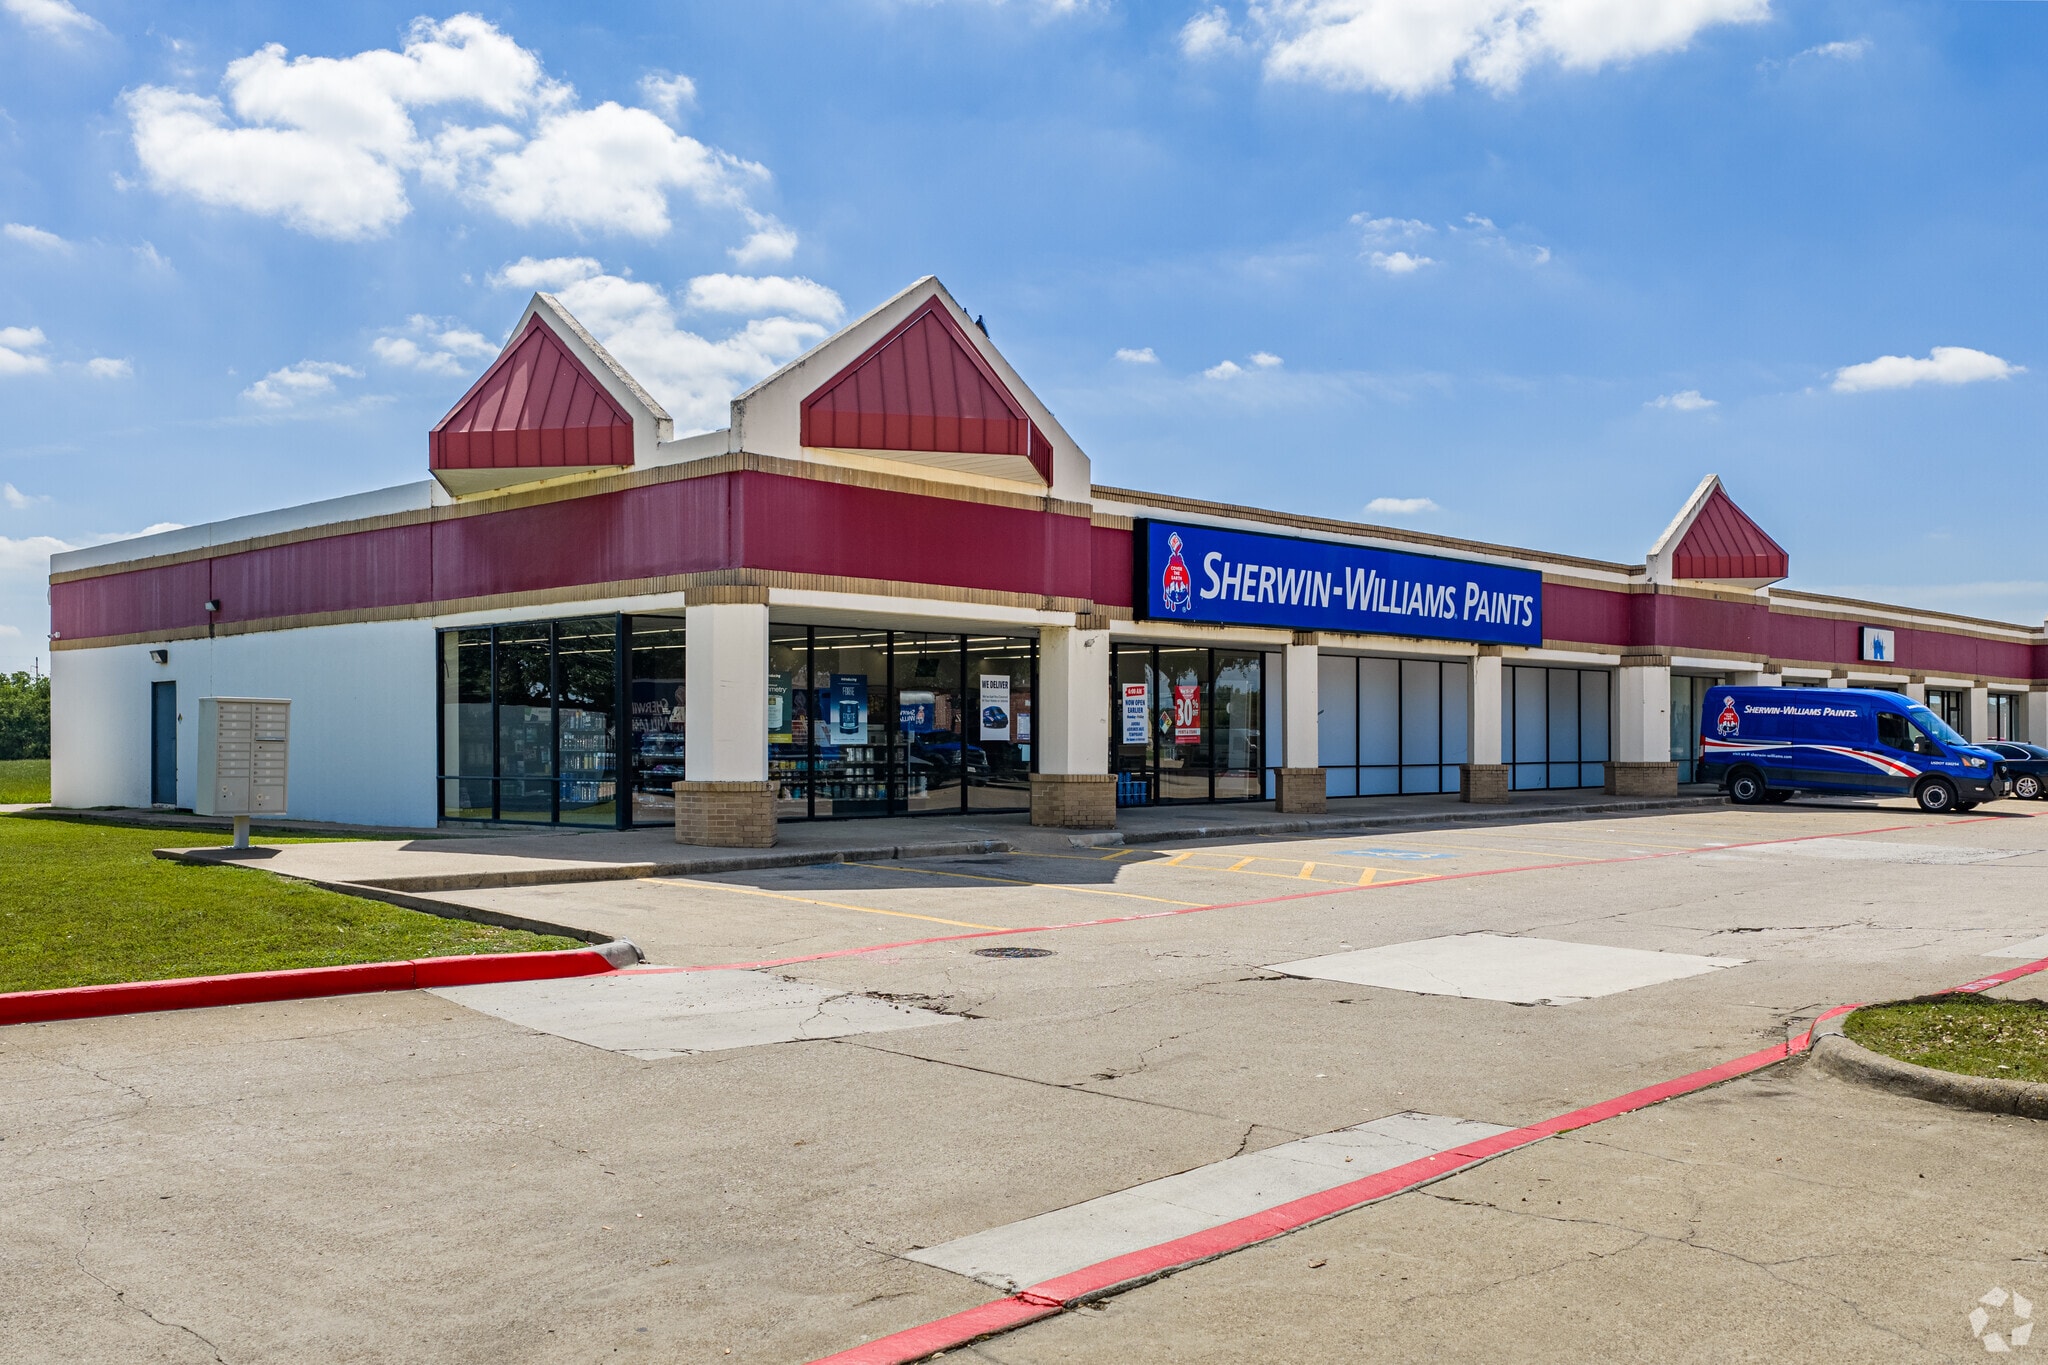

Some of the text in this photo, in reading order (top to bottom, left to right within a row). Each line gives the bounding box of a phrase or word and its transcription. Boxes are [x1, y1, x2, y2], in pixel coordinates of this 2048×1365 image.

[1200, 551, 1534, 627] SHERWIN-WILLIAMS PAINTS
[982, 680, 1008, 689] WE DELIVER
[1744, 705, 1821, 716] SHERWIN-WILLIAMS
